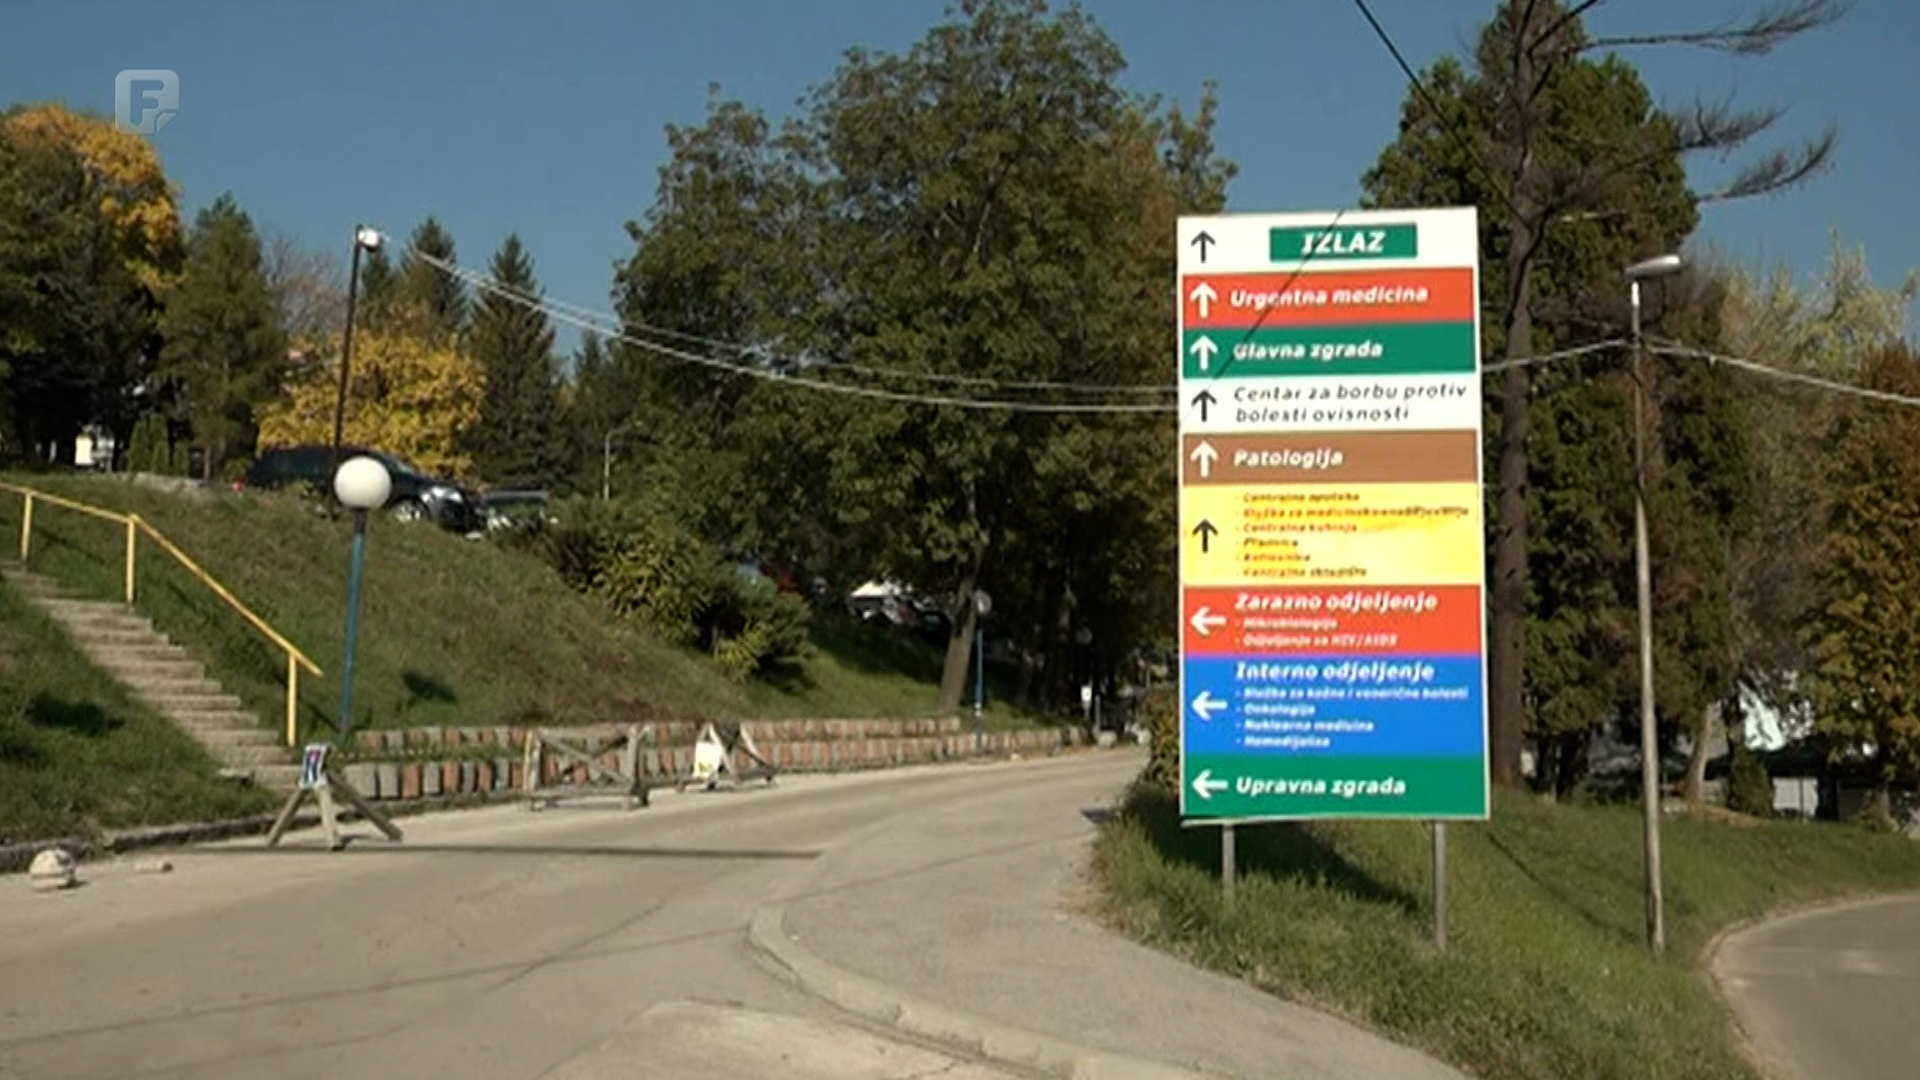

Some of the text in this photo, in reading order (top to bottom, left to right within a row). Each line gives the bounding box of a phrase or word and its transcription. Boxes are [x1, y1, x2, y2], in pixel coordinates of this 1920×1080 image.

[1302, 230, 1386, 253] IZLAZ
[1230, 286, 1429, 312] Urgentna medicina
[1233, 340, 1383, 362] Glavna zgrada
[1234, 382, 1467, 403] Centar za borbu protiv
[1235, 404, 1409, 423] bolesti ovisnosti
[1233, 448, 1344, 469] Patologija
[1235, 591, 1438, 614] Zarazno odjeljenje
[1236, 660, 1435, 684] Interno odjeljenje
[1236, 776, 1406, 797] Upravna zgrada
